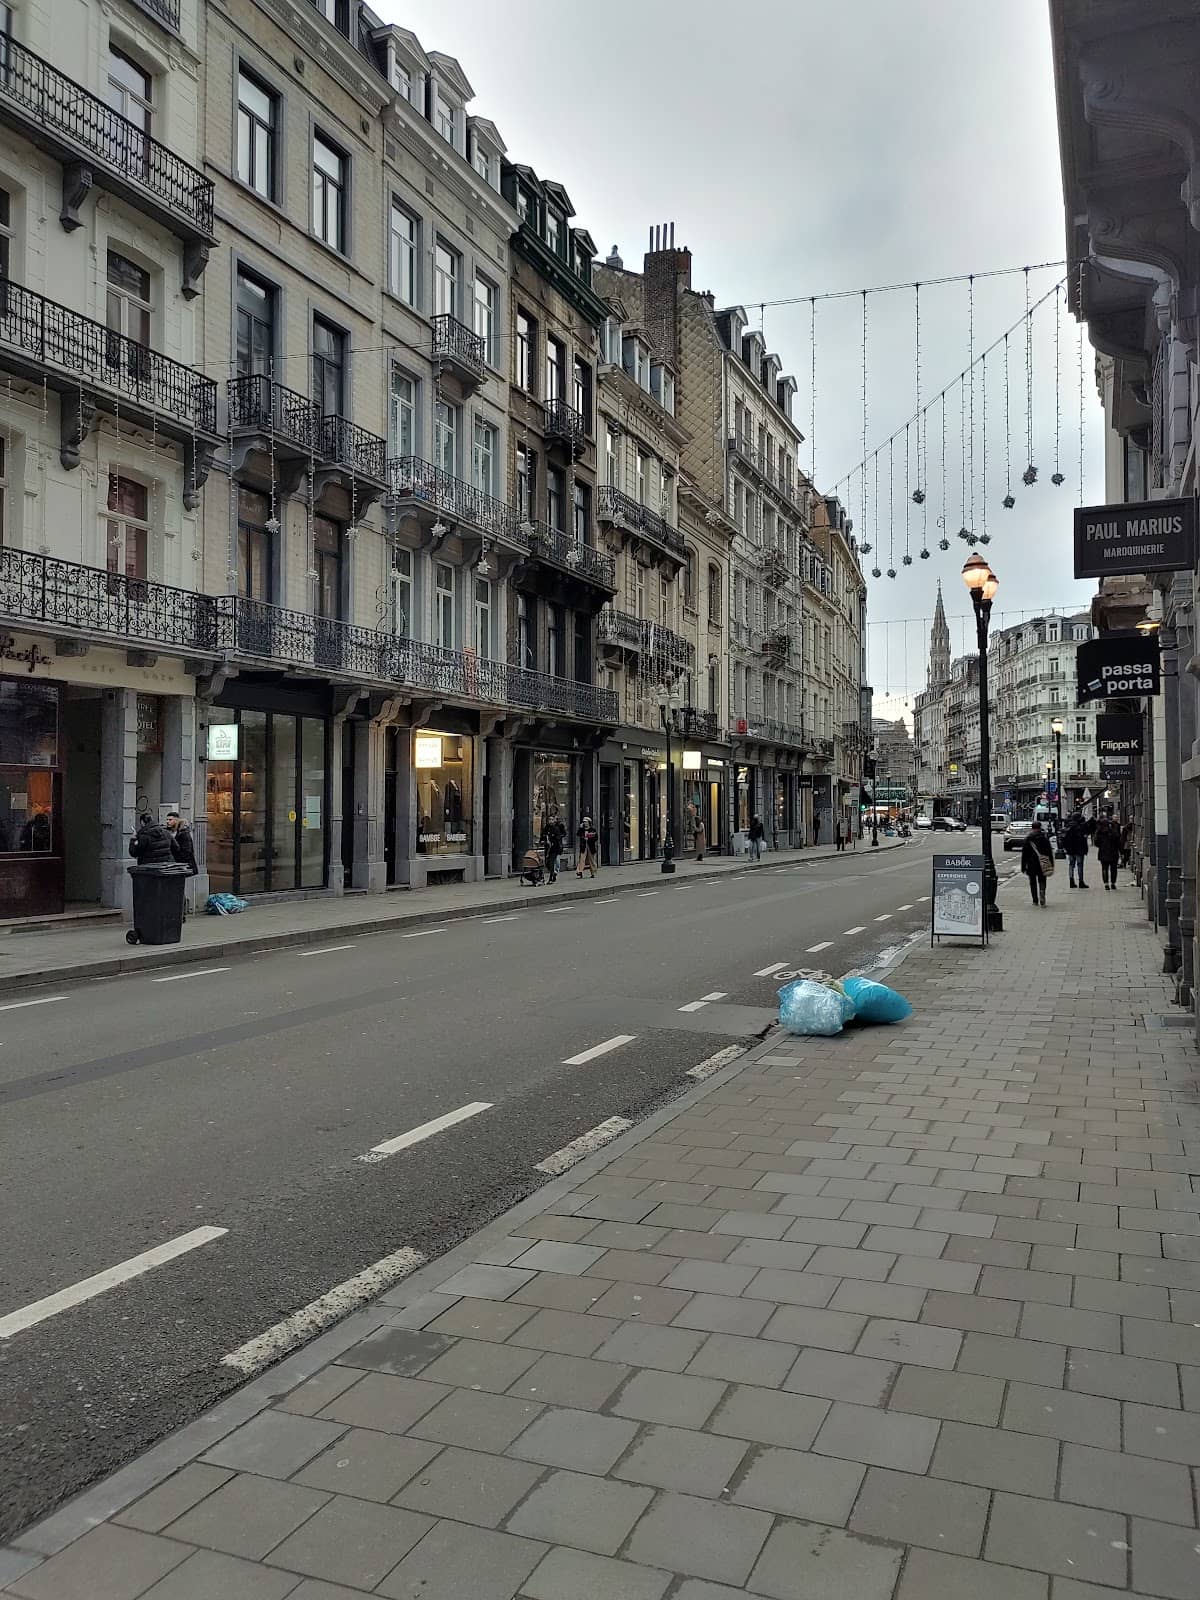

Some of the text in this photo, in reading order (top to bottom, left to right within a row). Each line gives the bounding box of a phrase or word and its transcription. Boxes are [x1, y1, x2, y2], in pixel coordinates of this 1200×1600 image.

[1086, 516, 1183, 541] PAUL MARIUS
[1103, 543, 1165, 558] MAROQUINERIE
[1102, 663, 1153, 679] passa
[1107, 676, 1154, 695] porta
[1100, 739, 1139, 751] Filippa K
